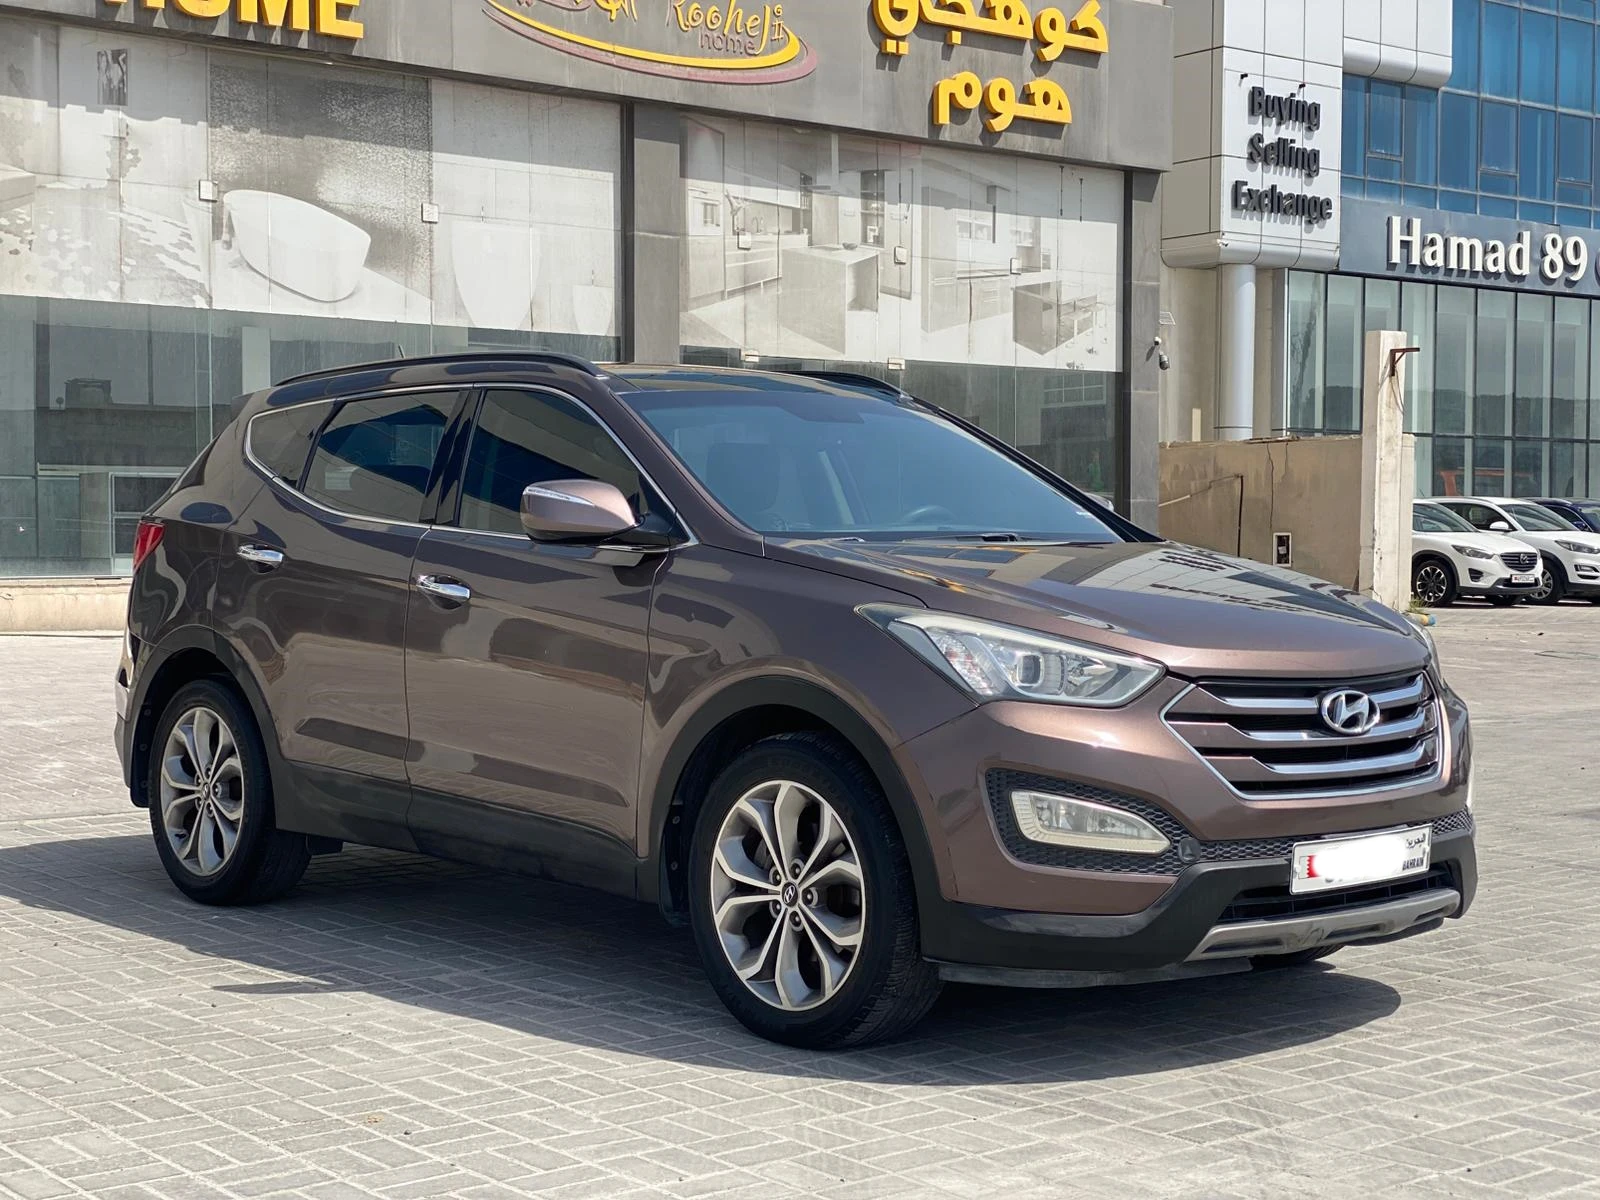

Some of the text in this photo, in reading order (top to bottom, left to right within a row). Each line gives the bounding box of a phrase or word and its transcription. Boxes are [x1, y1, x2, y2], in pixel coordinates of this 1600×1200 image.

[699, 27, 756, 56] home
[933, 71, 1072, 132] هوم
[1249, 86, 1320, 131] Buying
[1248, 133, 1320, 177] Selling
[1231, 180, 1333, 224] Exchange
[1387, 215, 1531, 276] Hamad
[1541, 233, 1588, 281] 89
